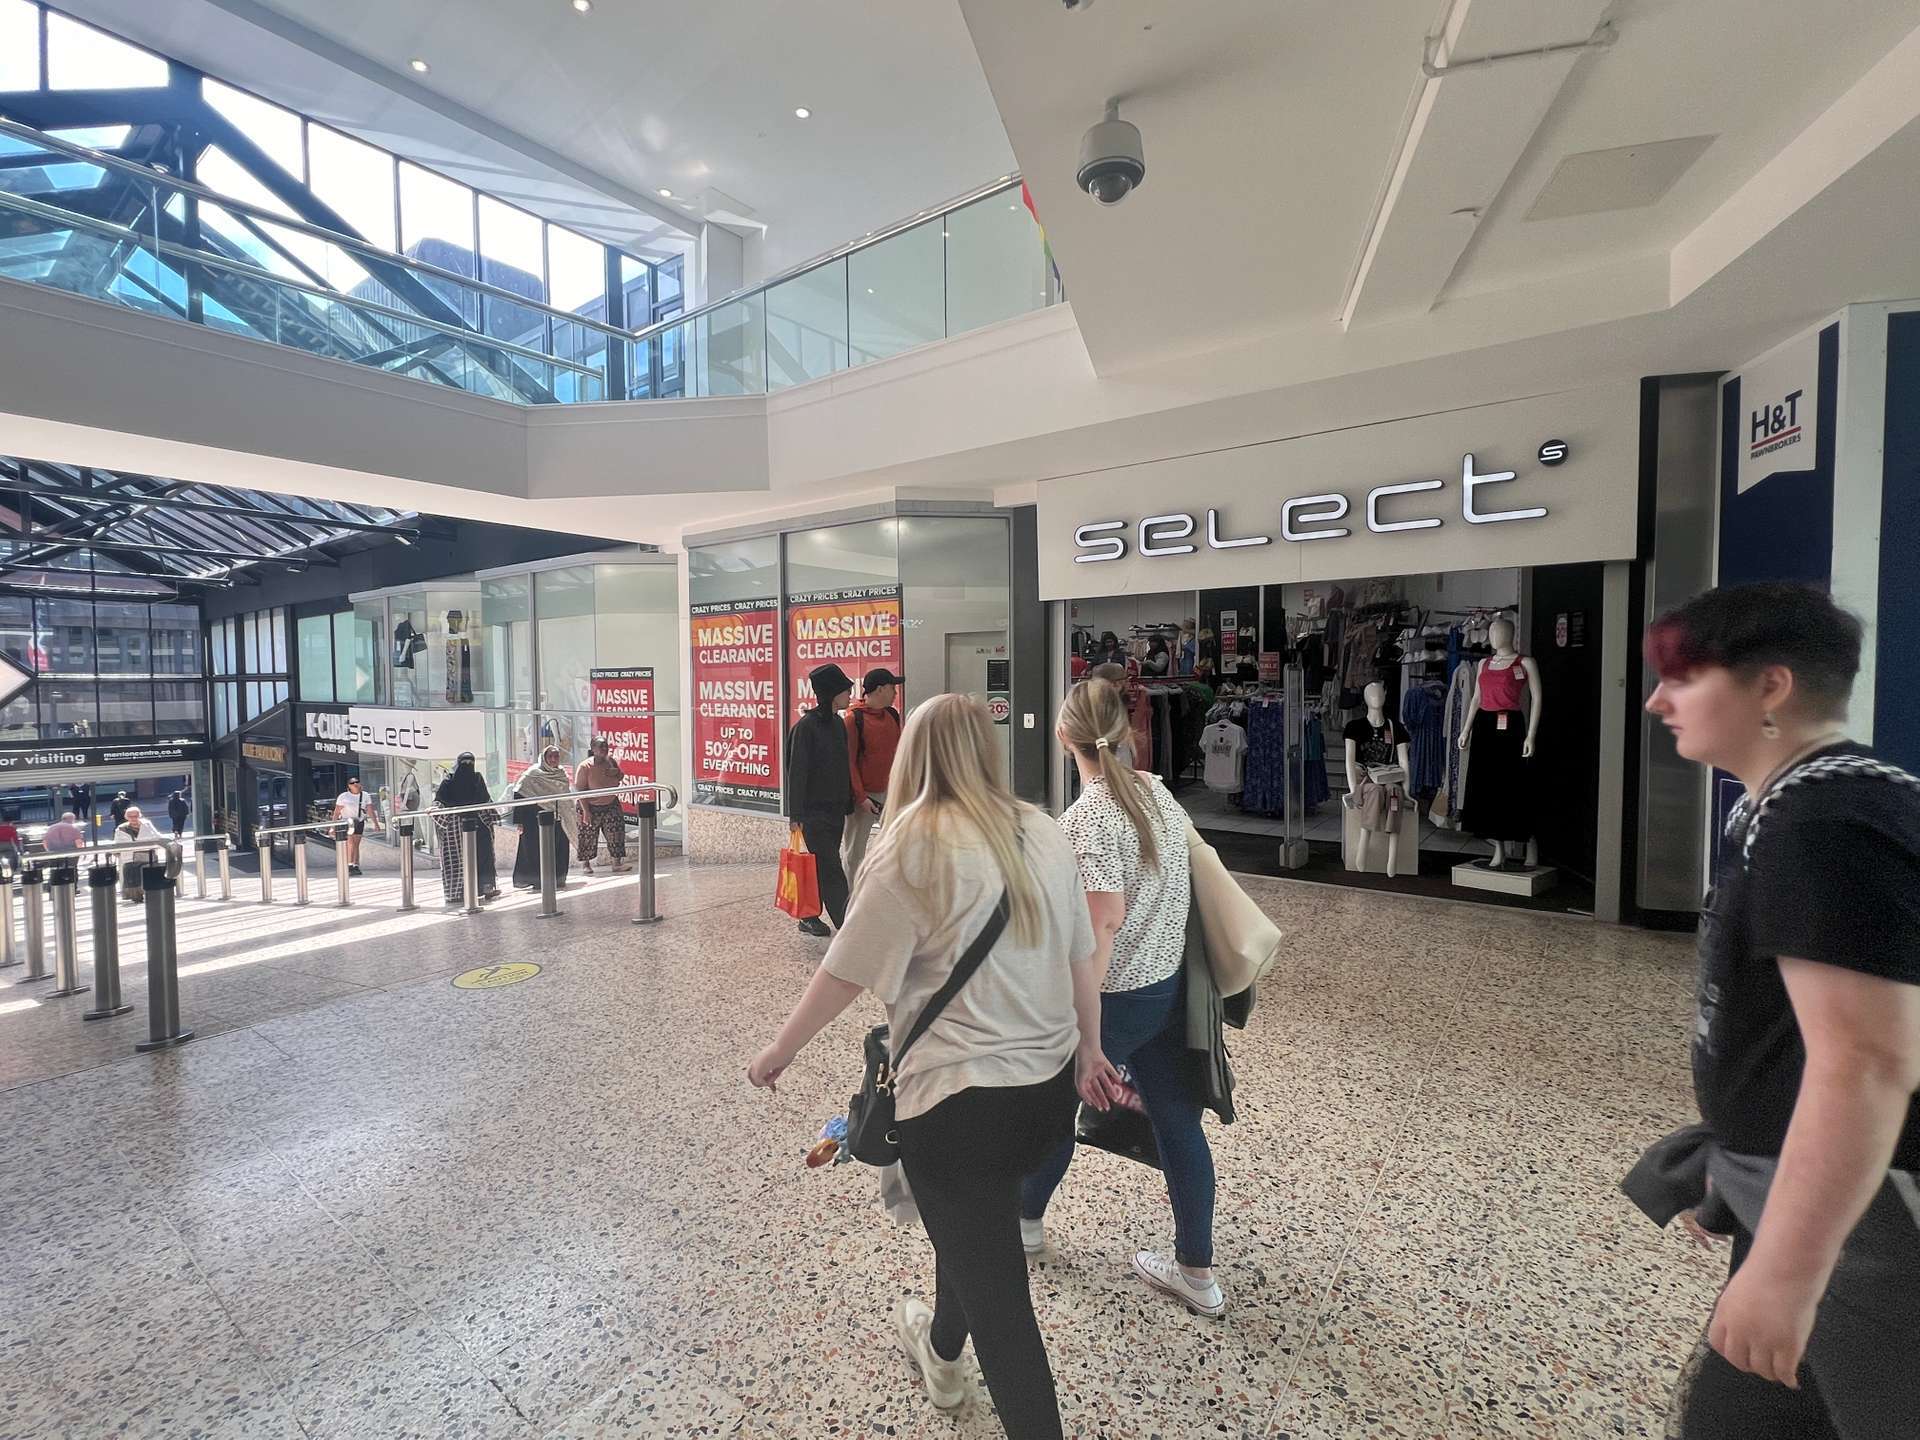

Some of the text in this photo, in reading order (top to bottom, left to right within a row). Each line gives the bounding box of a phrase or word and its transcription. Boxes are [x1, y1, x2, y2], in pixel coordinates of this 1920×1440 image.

[1751, 389, 1803, 443] H&T
[790, 586, 897, 603] CRAZY PRICES CRAZY PRICES
[692, 599, 778, 614] CRAZY PRICES CRAZY PRICES
[796, 613, 890, 640] MASSIVE
[698, 624, 773, 647] MASSIVE
[699, 647, 773, 664] CLEARANCE
[796, 640, 891, 659] CLEARANCE
[596, 688, 649, 705] MASSIVE
[699, 681, 774, 701] MASSIVE
[700, 703, 775, 719] CLEARANCE
[305, 712, 350, 741] K-CUBE
[720, 727, 753, 740] UP TO
[25, 753, 86, 765] visiting
[705, 741, 768, 761] 50% OFF
[703, 758, 770, 776] EVERYTHING
[697, 783, 715, 792] CRAZY
[715, 785, 734, 795] PRICES
[737, 788, 759, 798] CRAZY
